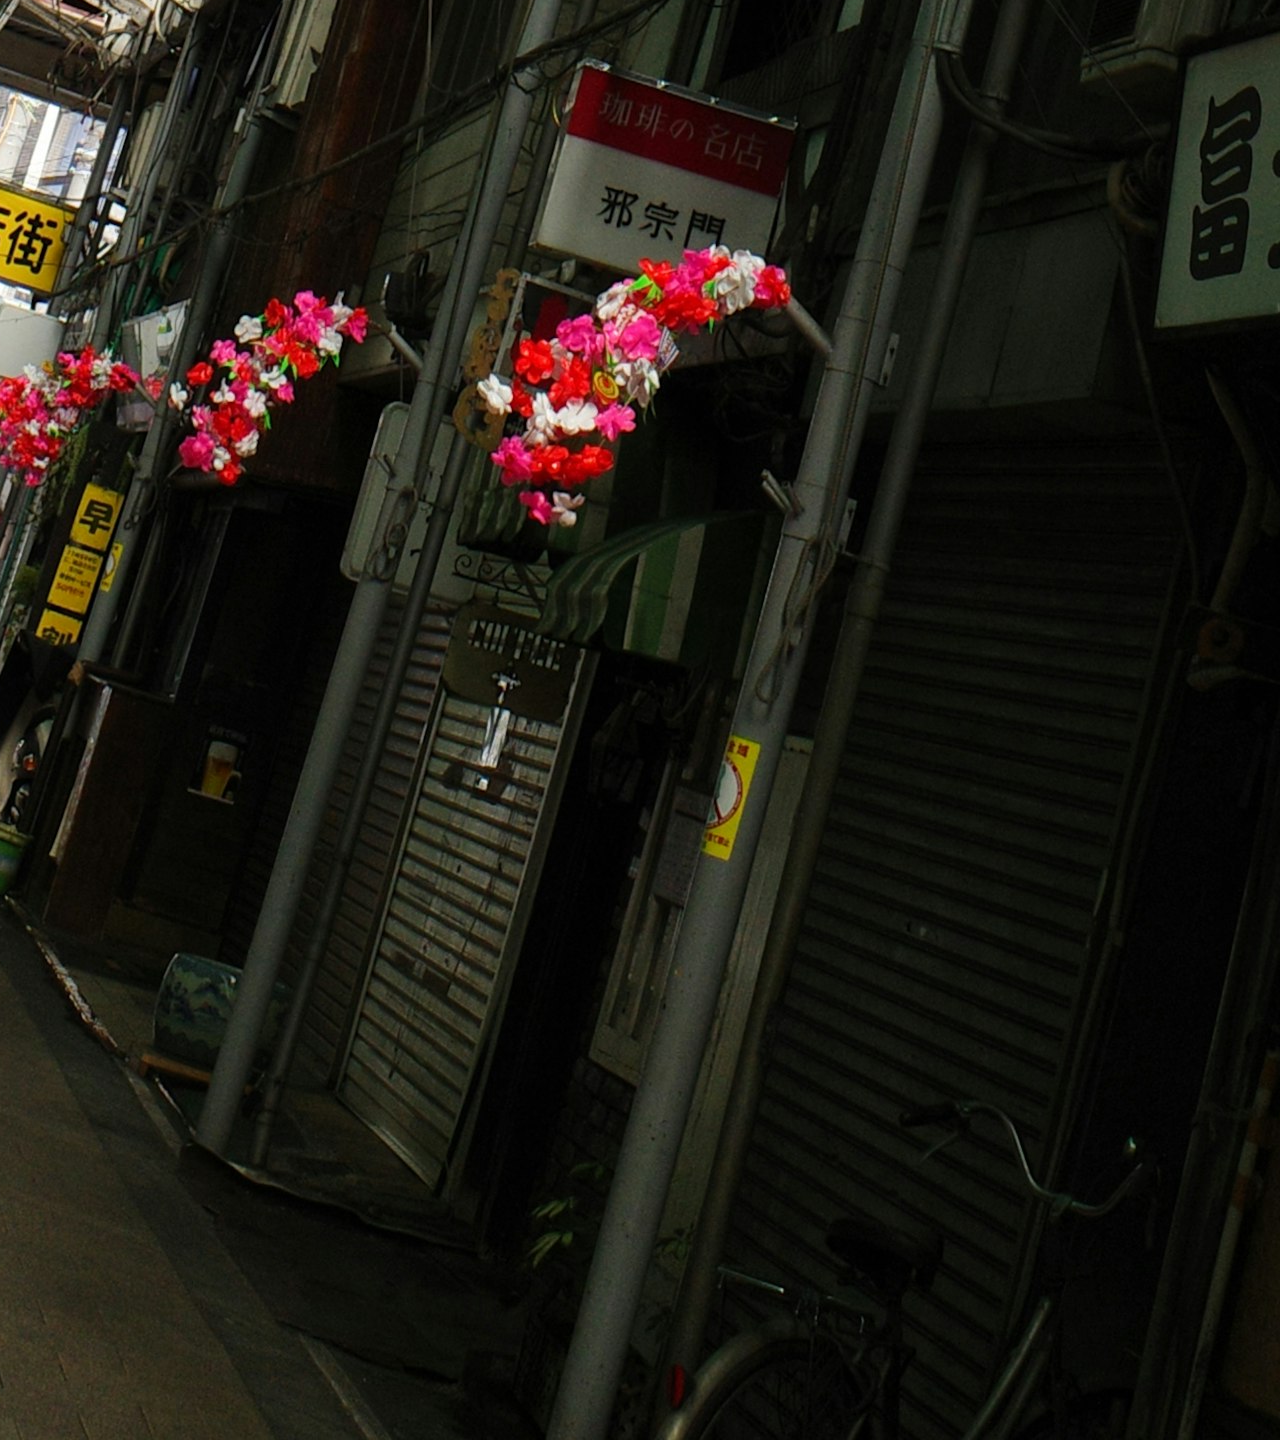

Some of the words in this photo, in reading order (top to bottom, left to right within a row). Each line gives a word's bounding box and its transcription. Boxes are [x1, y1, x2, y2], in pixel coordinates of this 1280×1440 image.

[598, 91, 768, 173] 珈琲の名店
[597, 184, 726, 248] 邪宗門
[78, 498, 114, 535] 早
